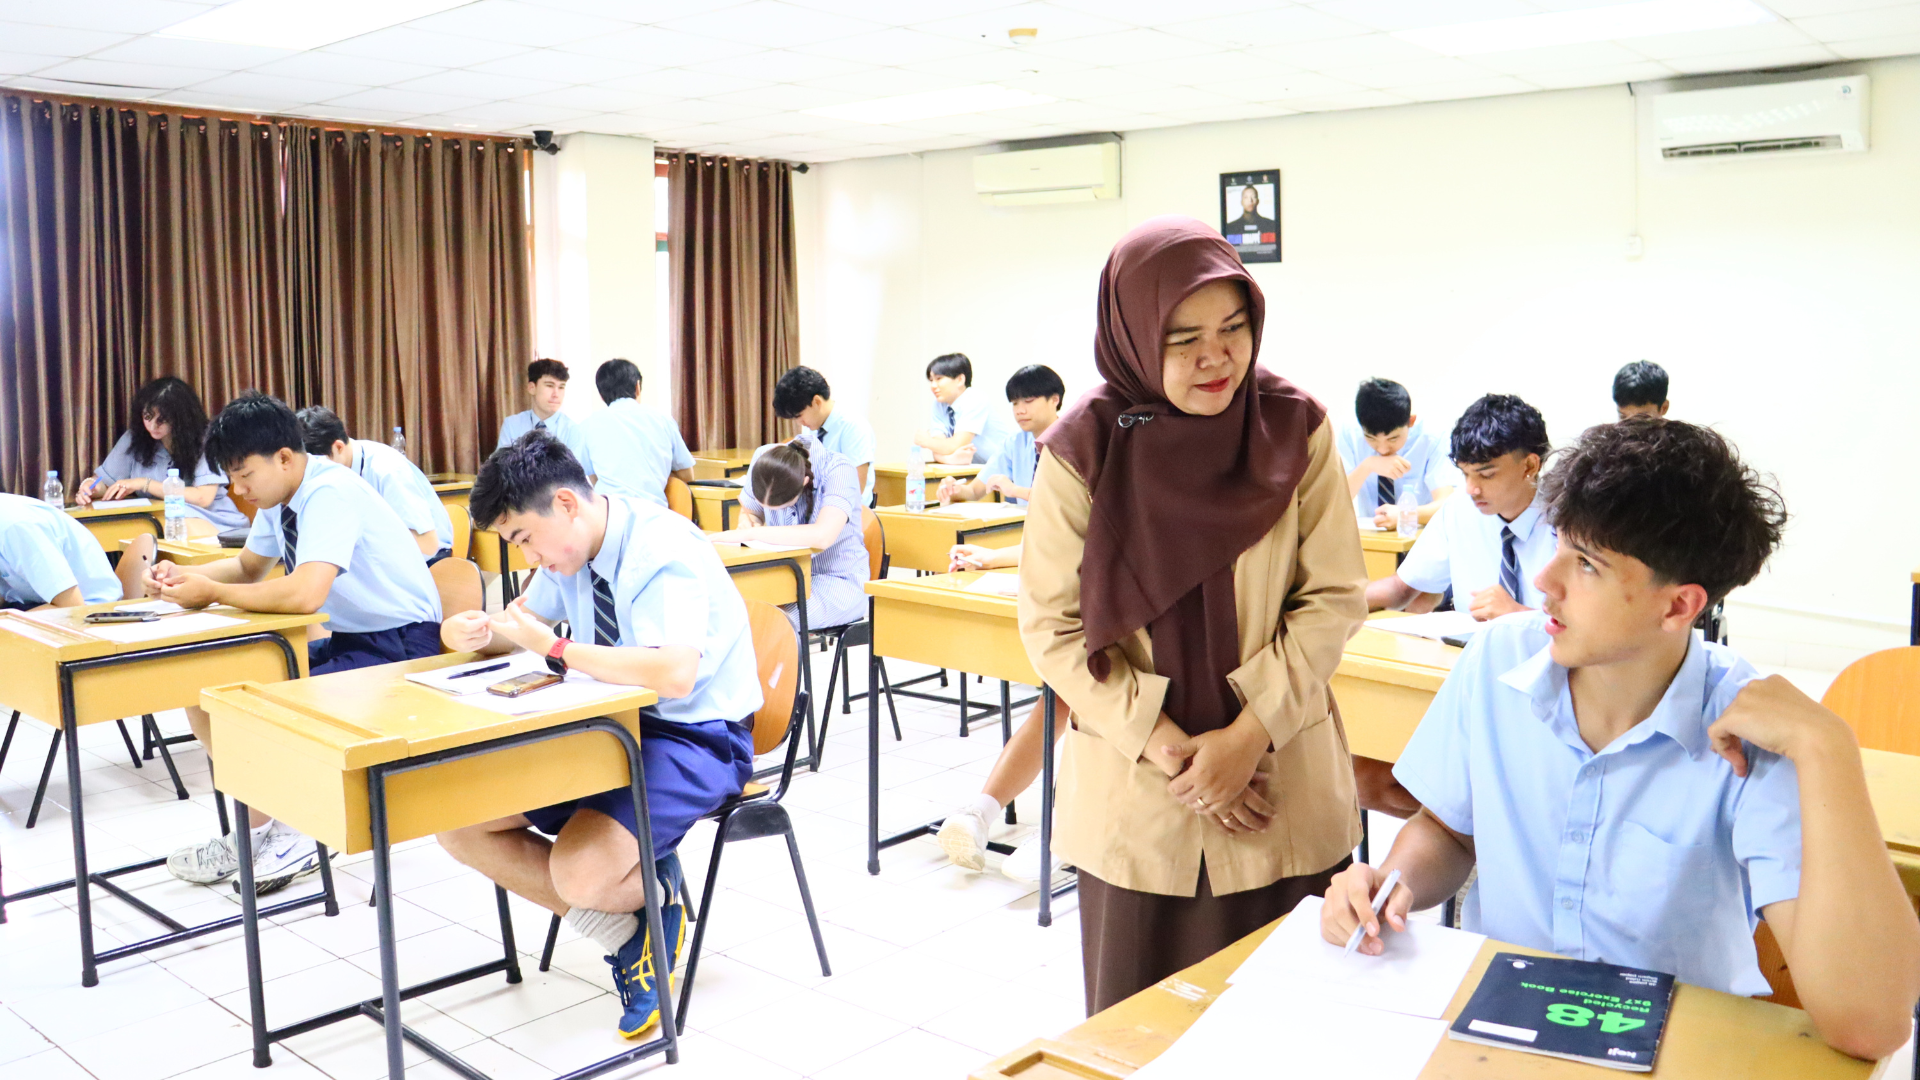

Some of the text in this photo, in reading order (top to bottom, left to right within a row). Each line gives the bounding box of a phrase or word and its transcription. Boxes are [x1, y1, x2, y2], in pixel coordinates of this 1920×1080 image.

[1521, 982, 1555, 993] Book
[1559, 988, 1620, 1003] Exercise
[1583, 998, 1650, 1013] Recycled
[1545, 1003, 1646, 1034] 48
